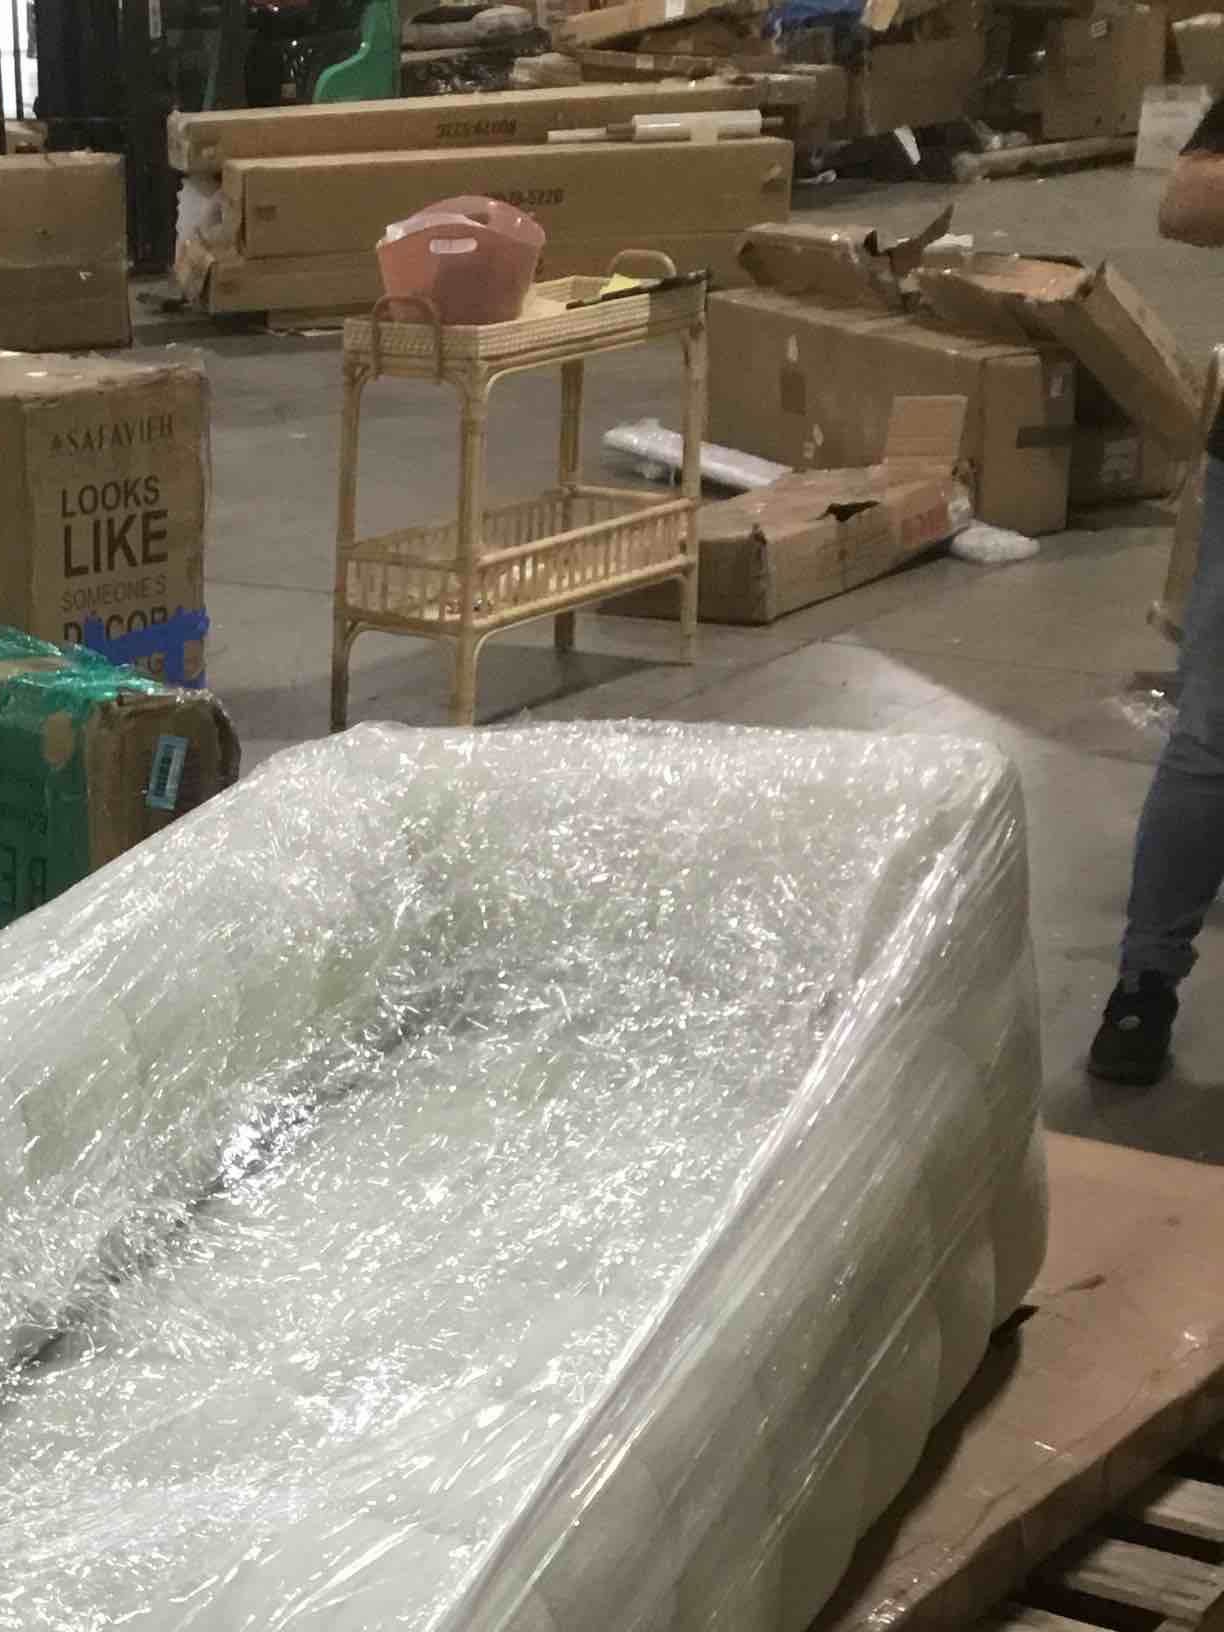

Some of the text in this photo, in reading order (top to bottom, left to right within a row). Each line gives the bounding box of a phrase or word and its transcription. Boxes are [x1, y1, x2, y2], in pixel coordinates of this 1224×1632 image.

[64, 413, 175, 456] SAFAVIEH
[61, 474, 161, 518] LOOKS
[63, 510, 169, 578] LIKE
